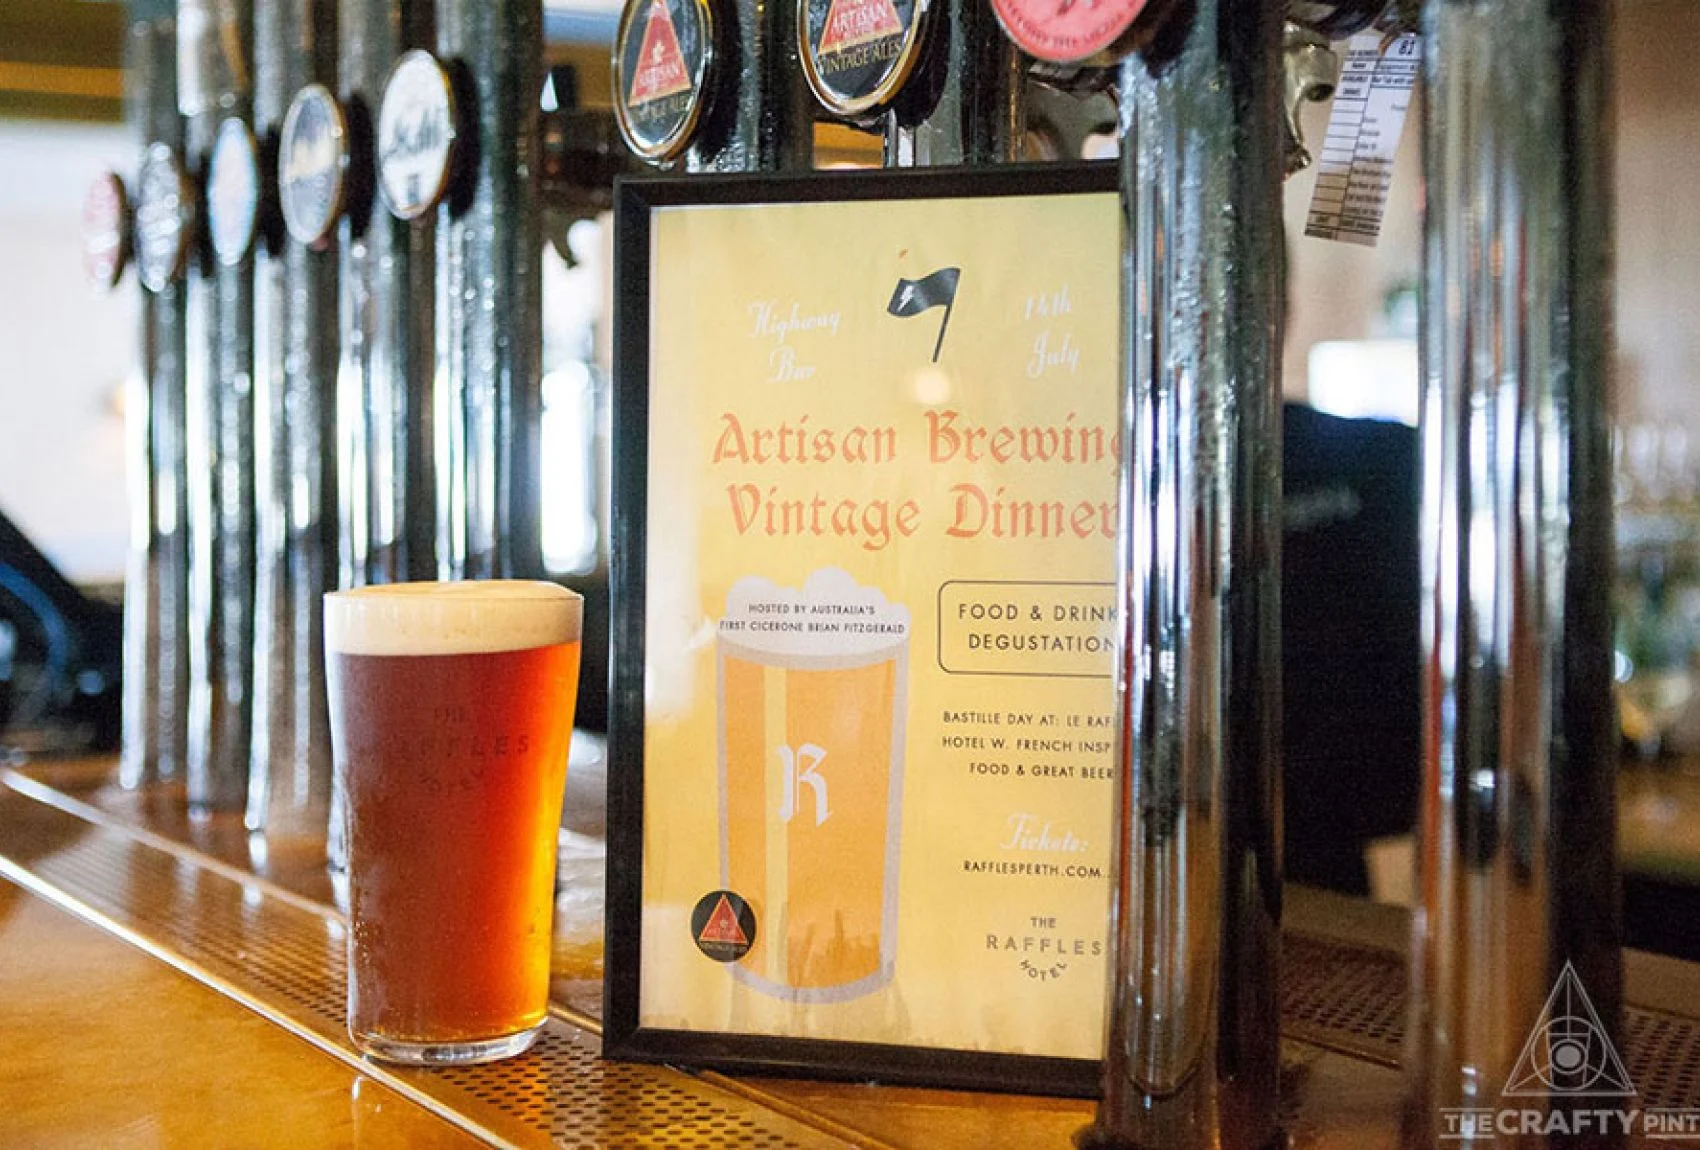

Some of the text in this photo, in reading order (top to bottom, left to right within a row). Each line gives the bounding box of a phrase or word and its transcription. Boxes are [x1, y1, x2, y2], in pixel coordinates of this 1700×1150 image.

[747, 299, 841, 343] Highway
[766, 345, 816, 383] Bar
[1026, 329, 1080, 380] July
[712, 412, 896, 464] Artisan
[726, 483, 1117, 551] Vintage Dinner
[749, 603, 875, 615] HOSTED BY AUSTRALIA'S
[958, 603, 1018, 620] FOOD
[1030, 604, 1042, 621] &
[719, 620, 905, 634] FIRST CICERONE BRIAN FITZGERALD
[943, 711, 1000, 724] BASTILLE
[1007, 714, 1033, 725] DAY
[1066, 715, 1080, 727] LE
[1087, 716, 1114, 728] RAF
[942, 736, 985, 749] HOTEL
[1016, 738, 1072, 752] FRENCH
[1078, 741, 1112, 753] INSP
[969, 762, 1010, 776] FOOD
[1015, 764, 1025, 776] &
[1031, 764, 1074, 778] GREAT
[963, 860, 1111, 879] RAFFLESPERTH.COM.
[1030, 916, 1056, 929] THE
[986, 934, 1102, 957] RAFFLES
[1020, 959, 1068, 982] HOTEL
